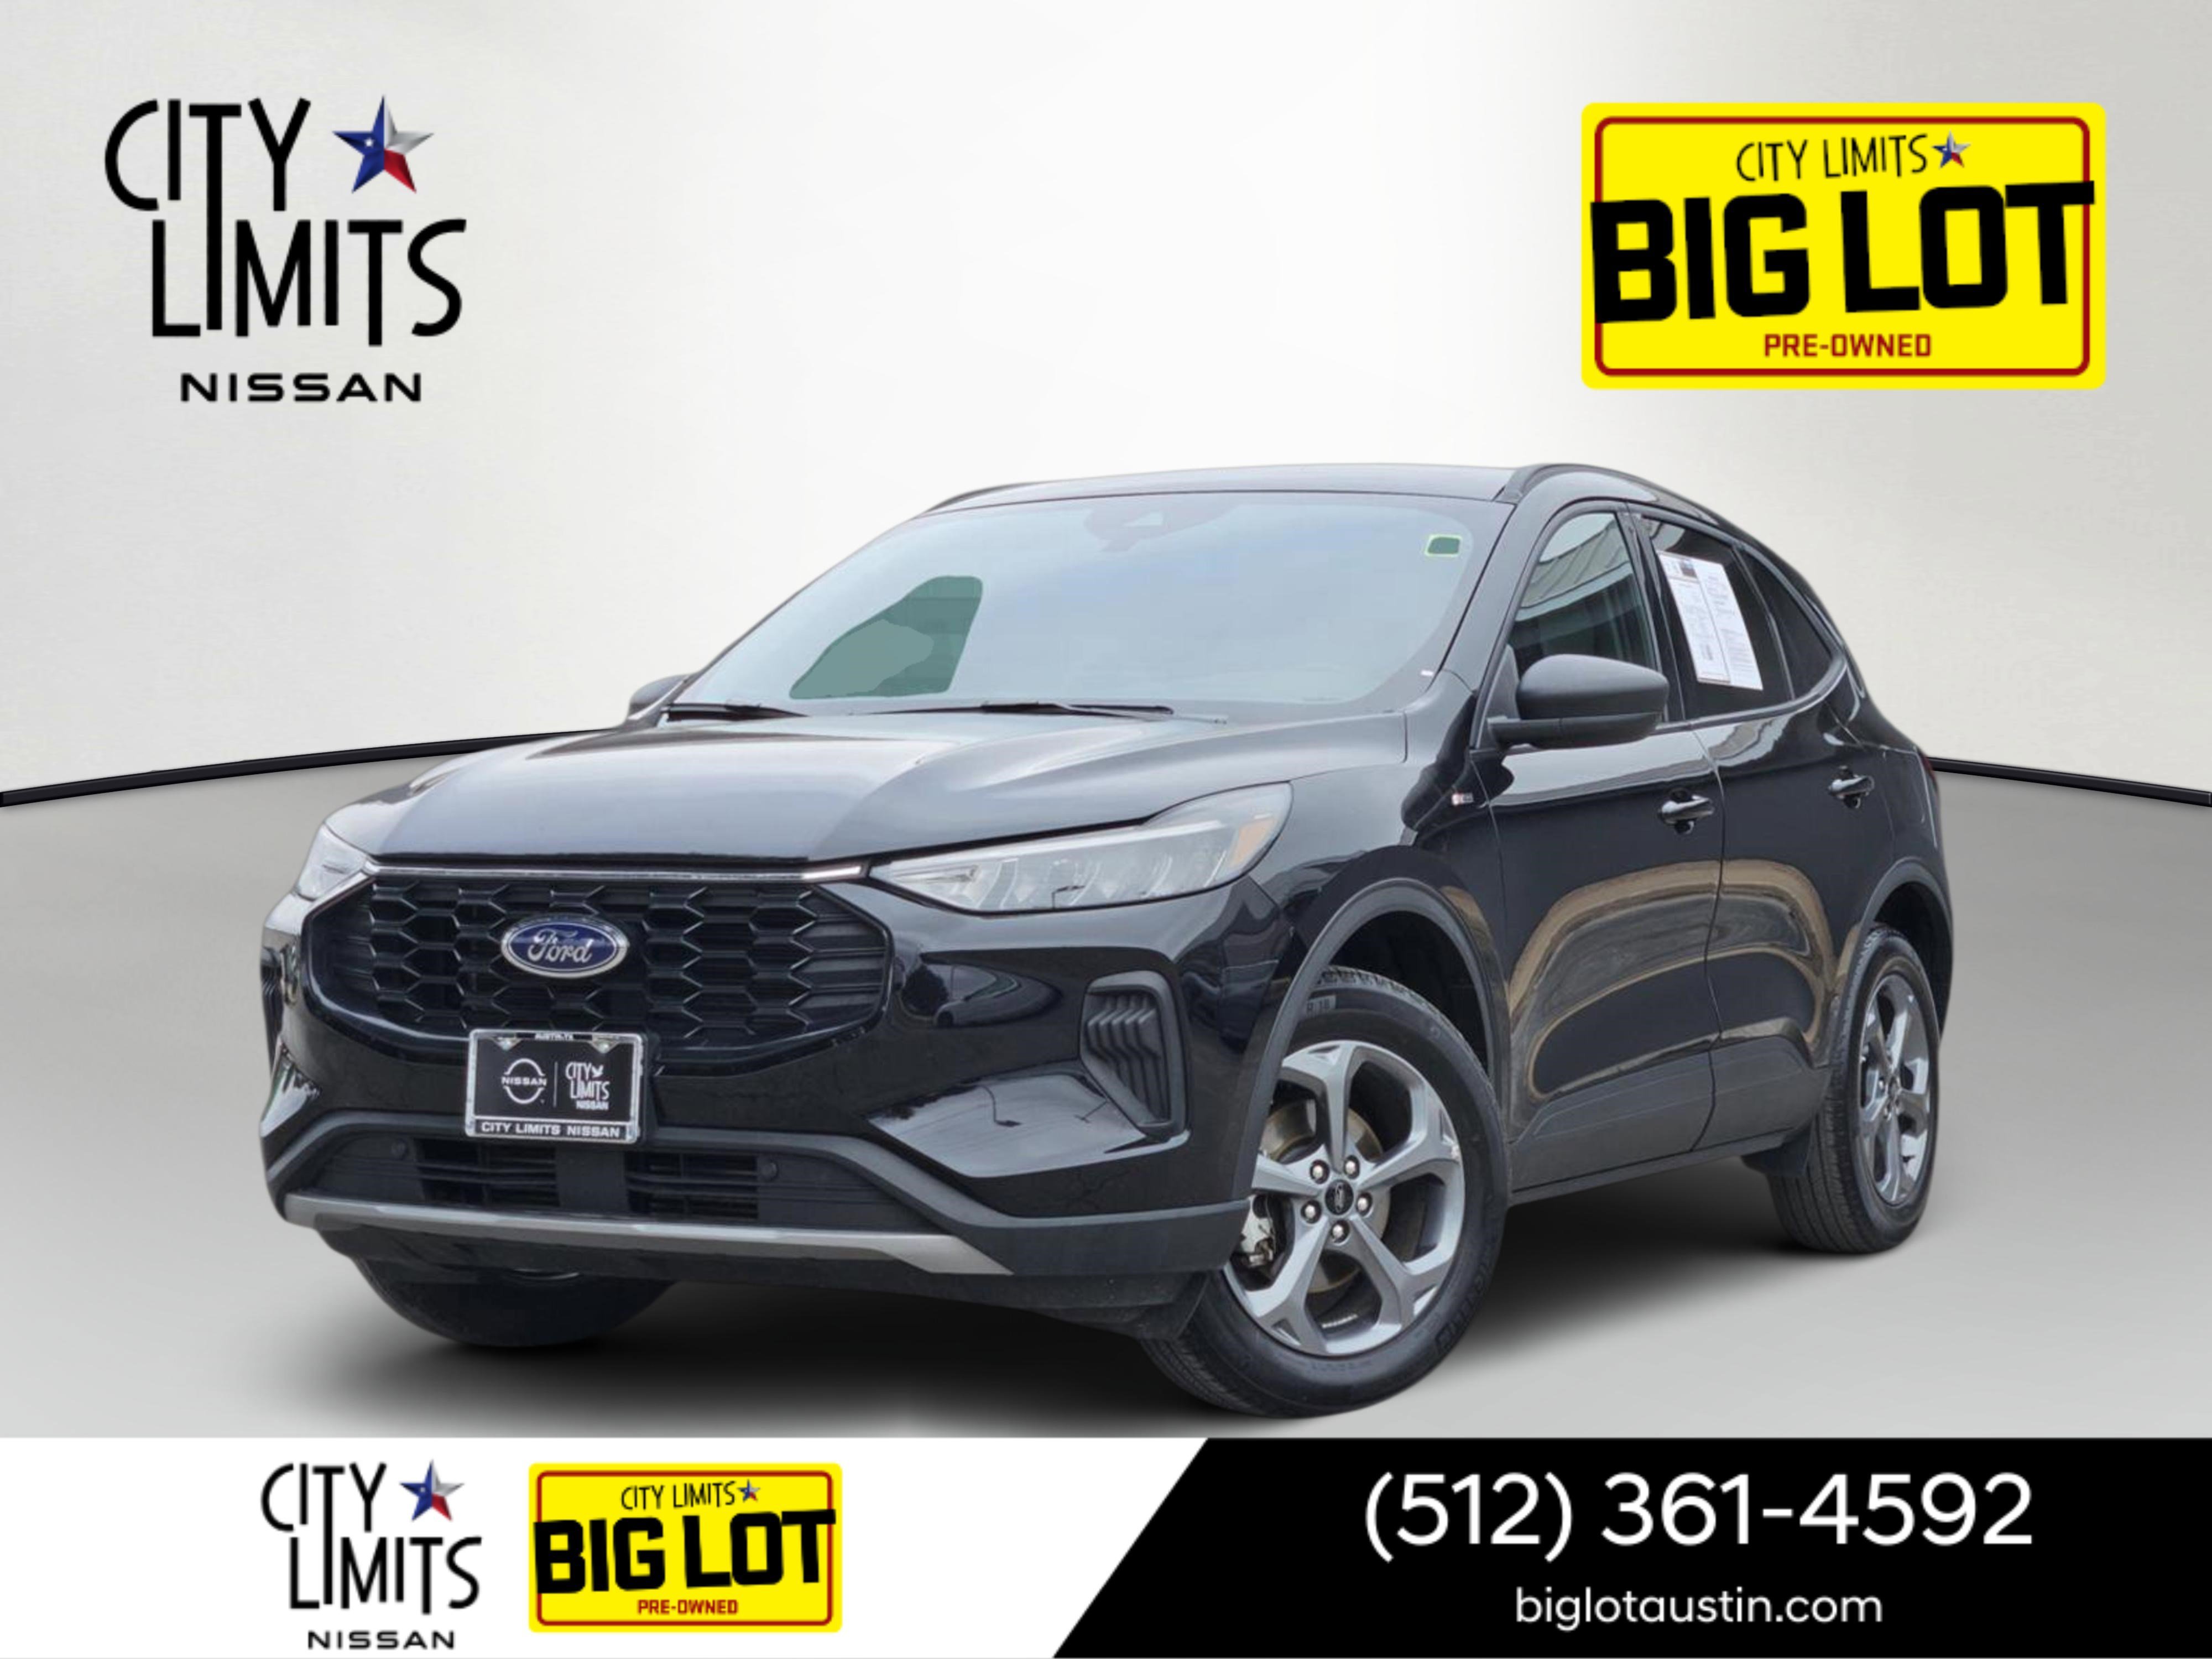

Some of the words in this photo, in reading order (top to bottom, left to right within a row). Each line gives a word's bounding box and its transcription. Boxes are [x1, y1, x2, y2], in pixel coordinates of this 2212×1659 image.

[528, 928, 593, 963] Ford
[565, 1062, 592, 1080] CITY
[501, 1077, 546, 1086] NISSAN
[570, 1080, 610, 1100] LIMITS
[481, 1121, 512, 1133] CITY
[515, 1123, 561, 1135] LIMITS
[567, 1125, 619, 1137] NISSAN
